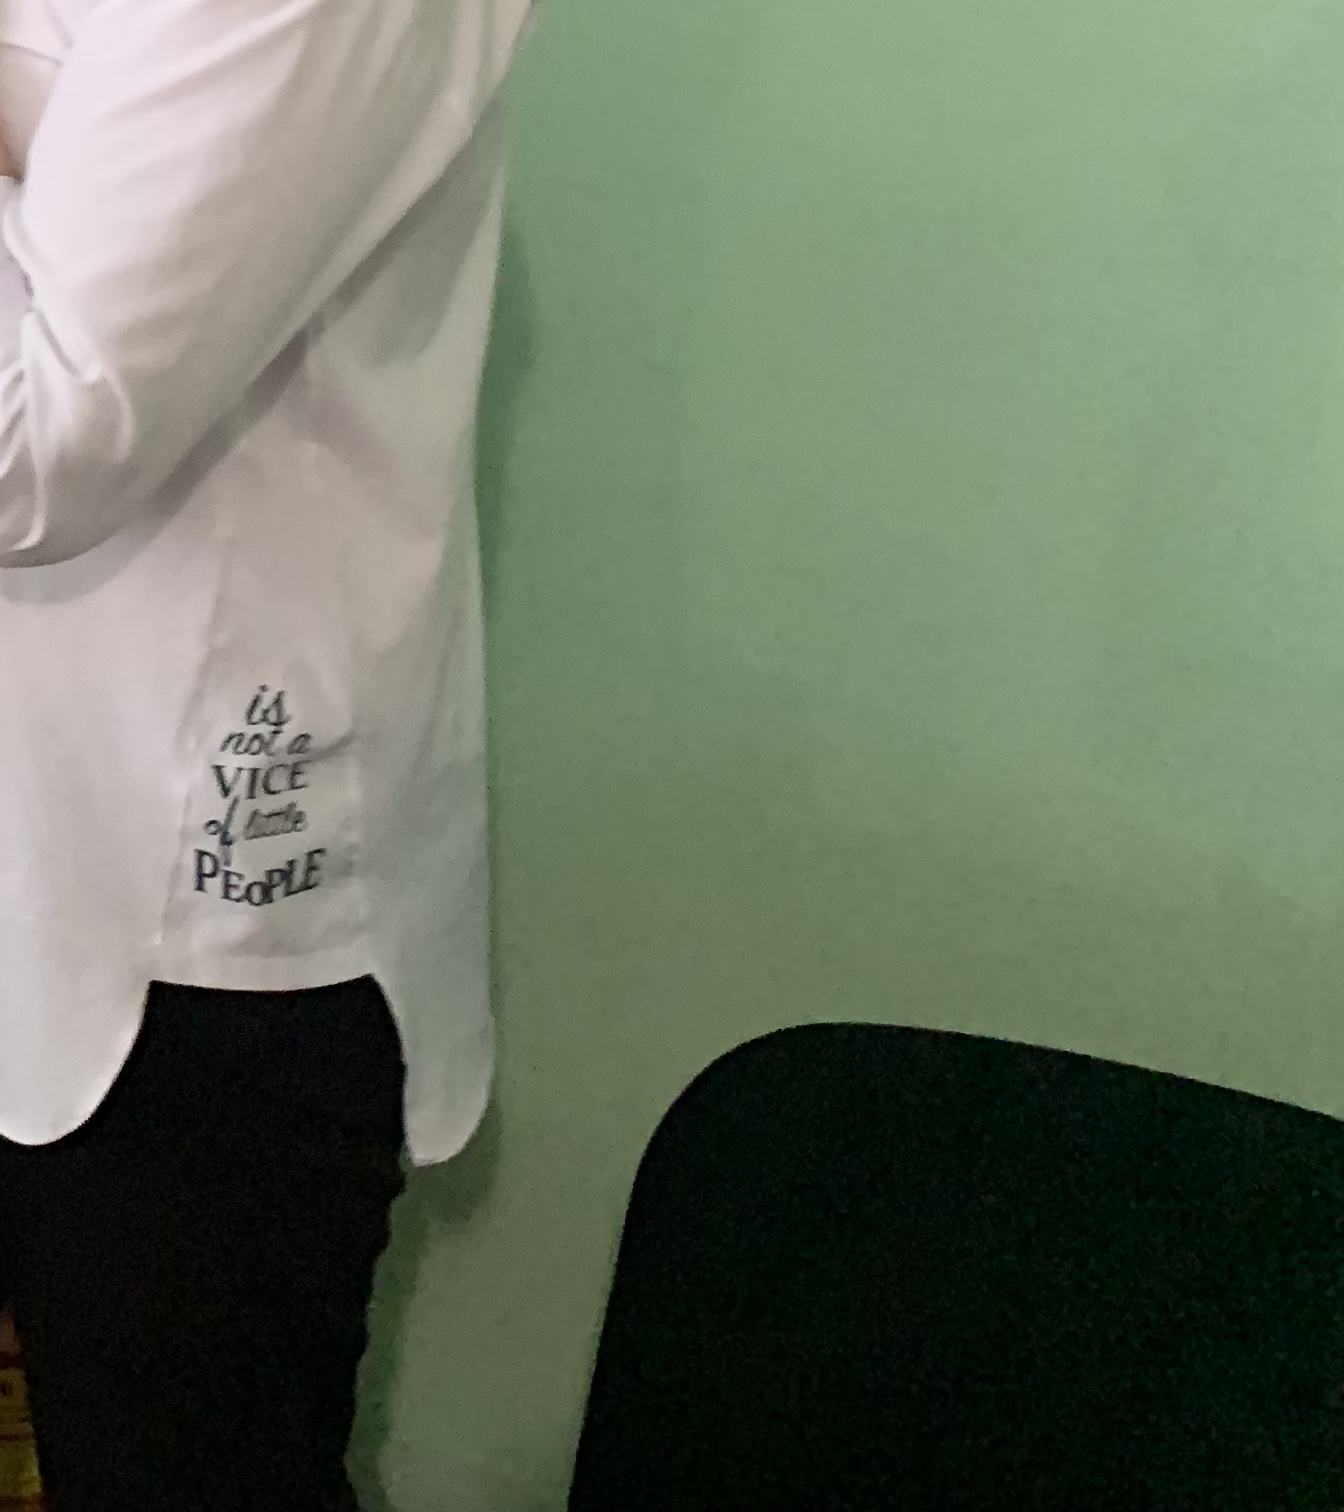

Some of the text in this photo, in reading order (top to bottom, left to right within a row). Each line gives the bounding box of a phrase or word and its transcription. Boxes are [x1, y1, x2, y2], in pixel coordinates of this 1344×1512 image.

[245, 684, 291, 727] is
[219, 729, 312, 756] not a
[211, 759, 311, 800] VICE
